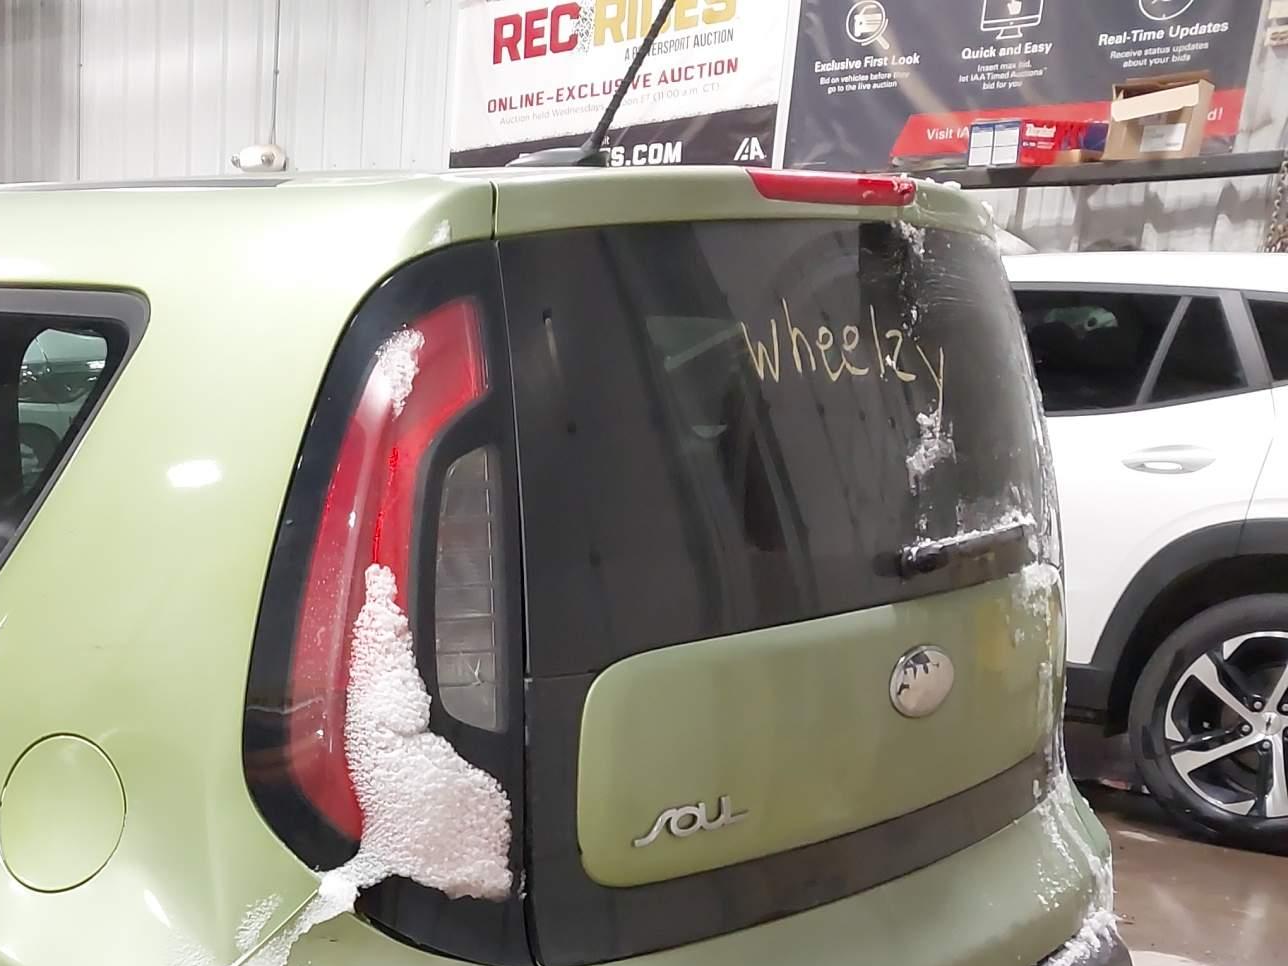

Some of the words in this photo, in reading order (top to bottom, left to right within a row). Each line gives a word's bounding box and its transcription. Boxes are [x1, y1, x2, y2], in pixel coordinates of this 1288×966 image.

[493, 2, 580, 64] REC
[1098, 29, 1165, 46] Real-Time
[1168, 21, 1229, 39] Updates
[625, 48, 630, 61] A
[693, 28, 734, 48] AUCTION
[961, 46, 996, 59] Quick
[998, 43, 1022, 57] and
[1023, 42, 1052, 55] Easy
[1110, 49, 1143, 60] Receive
[1144, 46, 1171, 56] status
[1172, 42, 1209, 53] updates
[814, 58, 862, 73] Exclusive
[863, 55, 889, 68] First
[891, 52, 920, 65] Look
[1123, 58, 1147, 68] about
[1149, 55, 1170, 67] your
[1171, 53, 1191, 62] bids
[487, 72, 652, 114] ONLINE-EXCLUSVE
[657, 57, 739, 86] AUCTION
[841, 73, 869, 83] vehicles
[870, 71, 892, 81] before
[827, 86, 836, 95] go
[837, 84, 845, 92] to
[845, 83, 856, 91] the
[857, 82, 871, 90] live
[872, 80, 897, 89] auction
[926, 127, 953, 141] Visit
